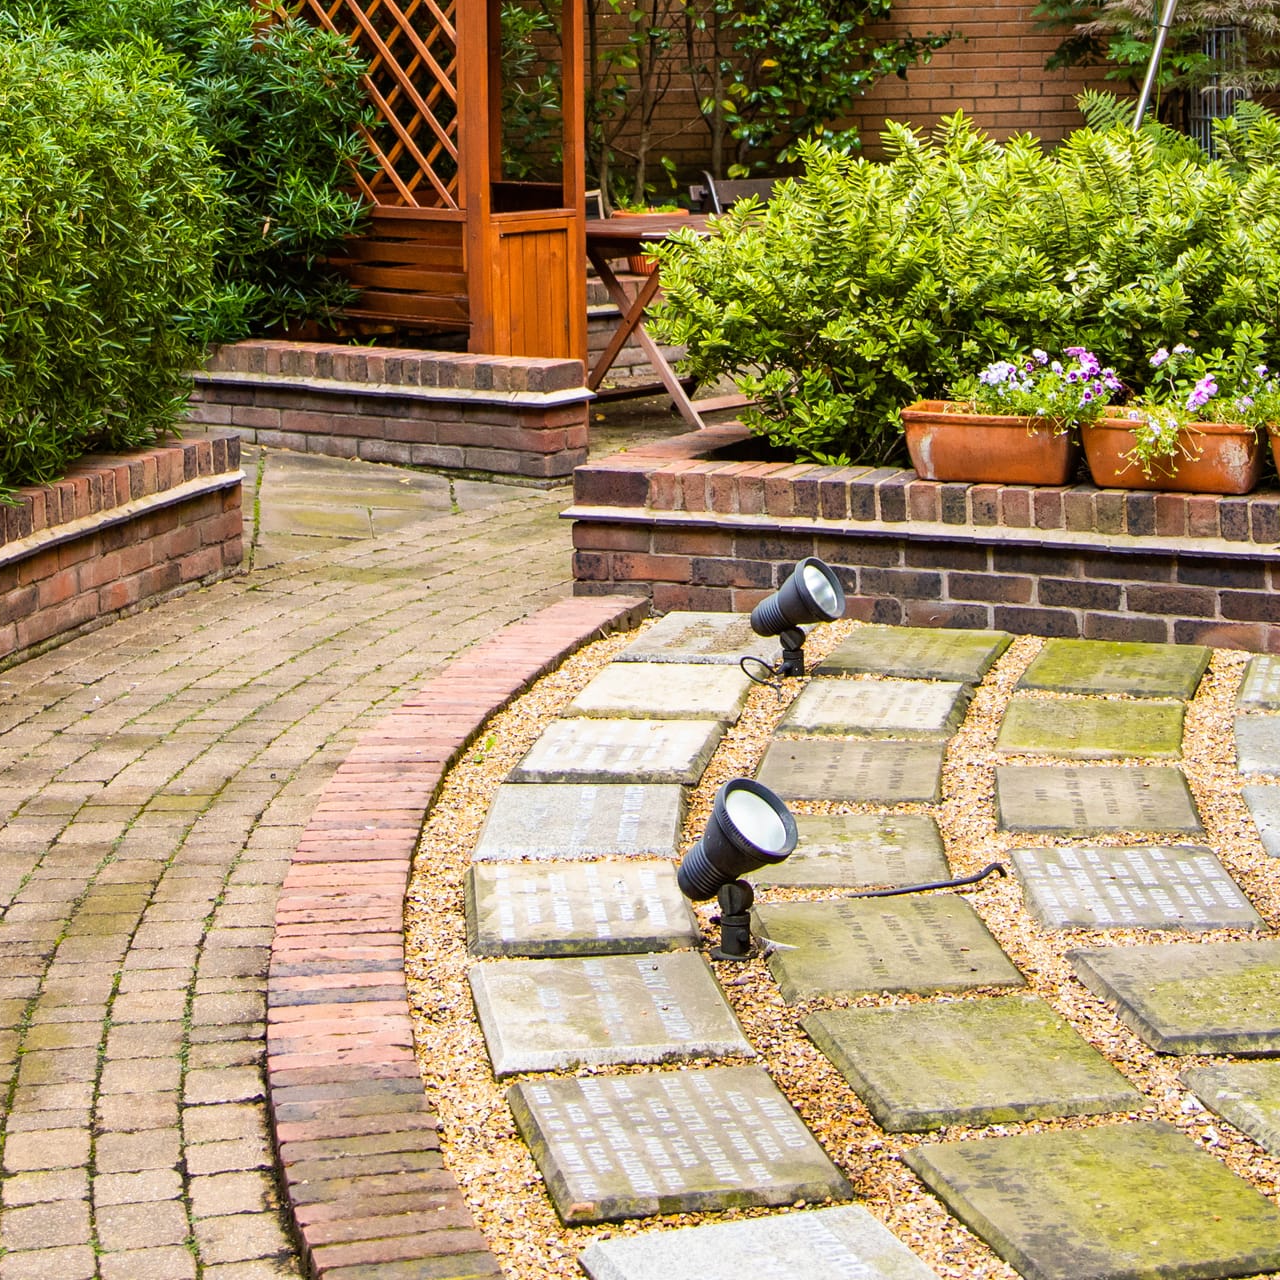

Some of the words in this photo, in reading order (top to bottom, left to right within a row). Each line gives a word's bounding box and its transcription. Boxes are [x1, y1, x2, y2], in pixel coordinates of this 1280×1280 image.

[1122, 850, 1158, 885] CATHERINE
[1147, 888, 1180, 917] GIBBINS
[1174, 860, 1195, 874] AGED
[1191, 856, 1222, 877] SARAH
[1209, 880, 1244, 908] GIBBINS
[1171, 884, 1196, 904] MONTH
[633, 958, 671, 989] HENRY
[649, 993, 697, 1040] CADBURY
[563, 1102, 588, 1123] AGED
[644, 1096, 671, 1119] AGED
[688, 1074, 714, 1092] DIED
[710, 1108, 731, 1119] OF
[724, 1130, 759, 1160] MONTH
[723, 1090, 753, 1112] AGED
[753, 1095, 788, 1117] ANN
[529, 1085, 553, 1104] DIED
[545, 1120, 566, 1130] OF
[557, 1141, 588, 1172] MONTH
[574, 1077, 613, 1114] RICHARD
[596, 1116, 632, 1149] TAPPER
[614, 1150, 658, 1194] CADBURY
[609, 1079, 634, 1098] DIED
[627, 1112, 647, 1121] OF
[640, 1136, 673, 1166] MONTH
[657, 1077, 708, 1130] ELIZABETH
[692, 1133, 742, 1183] CADBURY
[769, 1119, 809, 1147] HEAD
